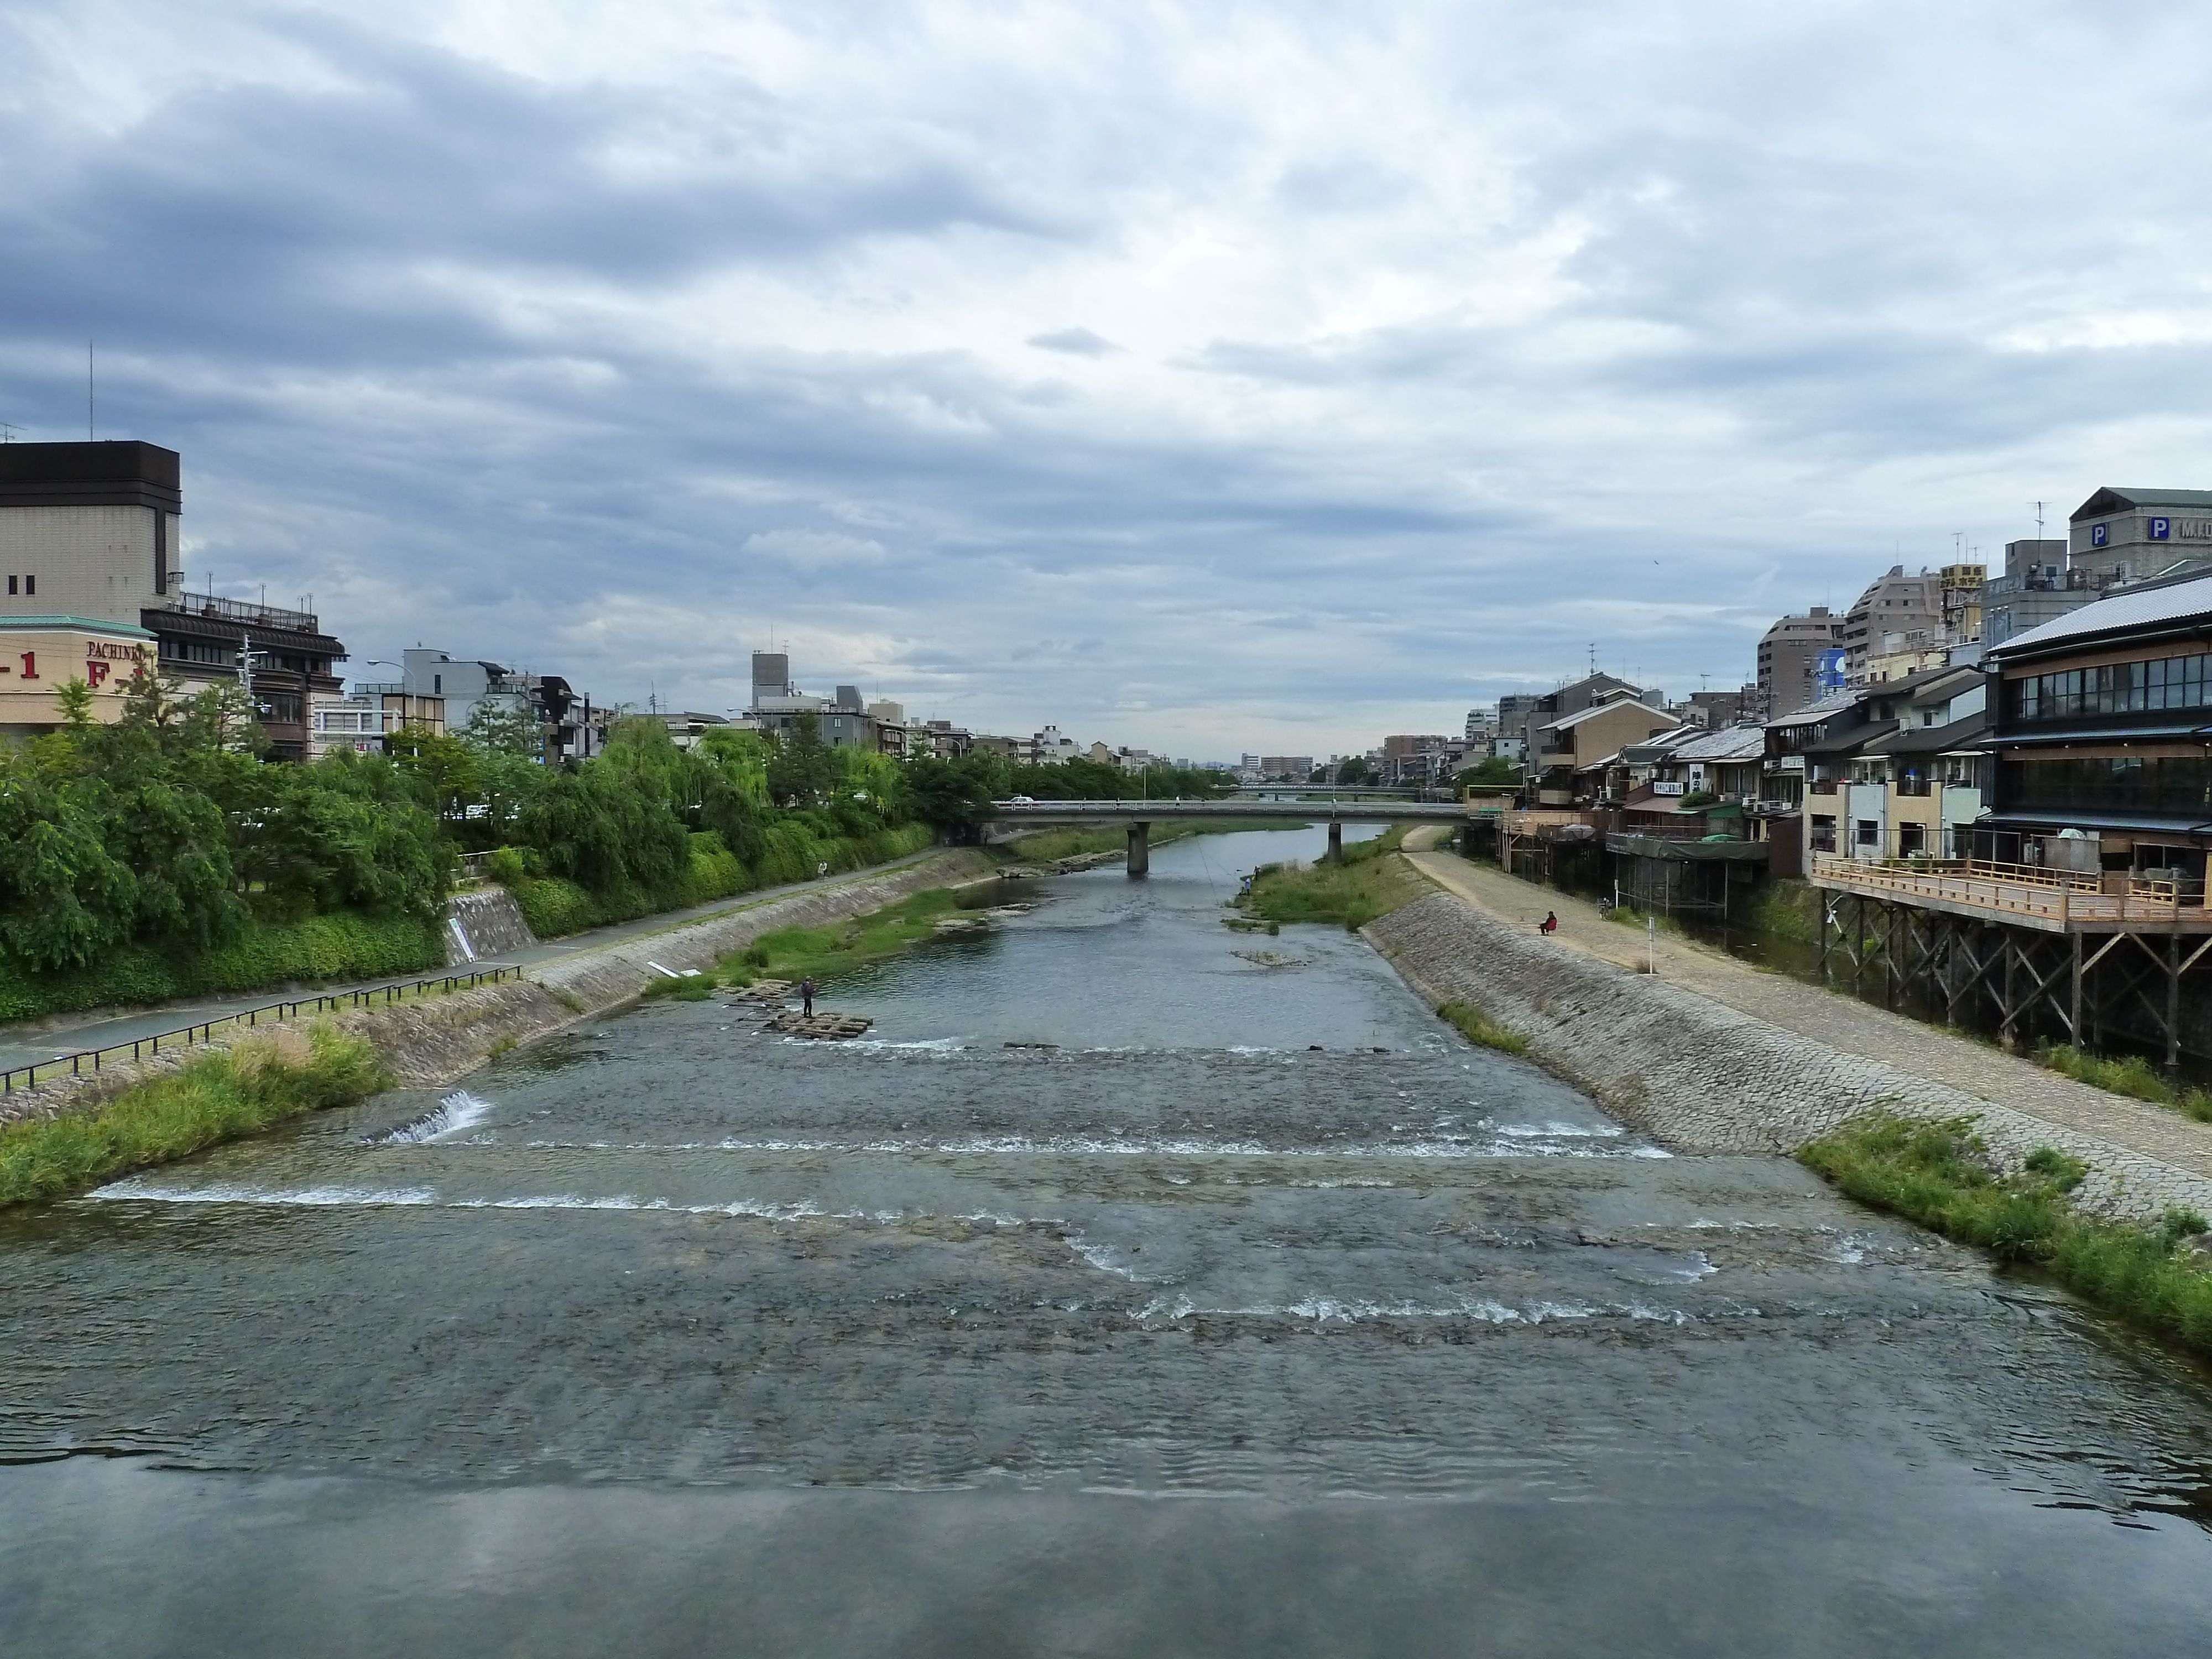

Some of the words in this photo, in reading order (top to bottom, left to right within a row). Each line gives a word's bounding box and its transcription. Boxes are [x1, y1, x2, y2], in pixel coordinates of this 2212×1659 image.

[2094, 526, 2105, 544] P
[2153, 519, 2167, 537] P
[86, 641, 145, 662] PACHINKO
